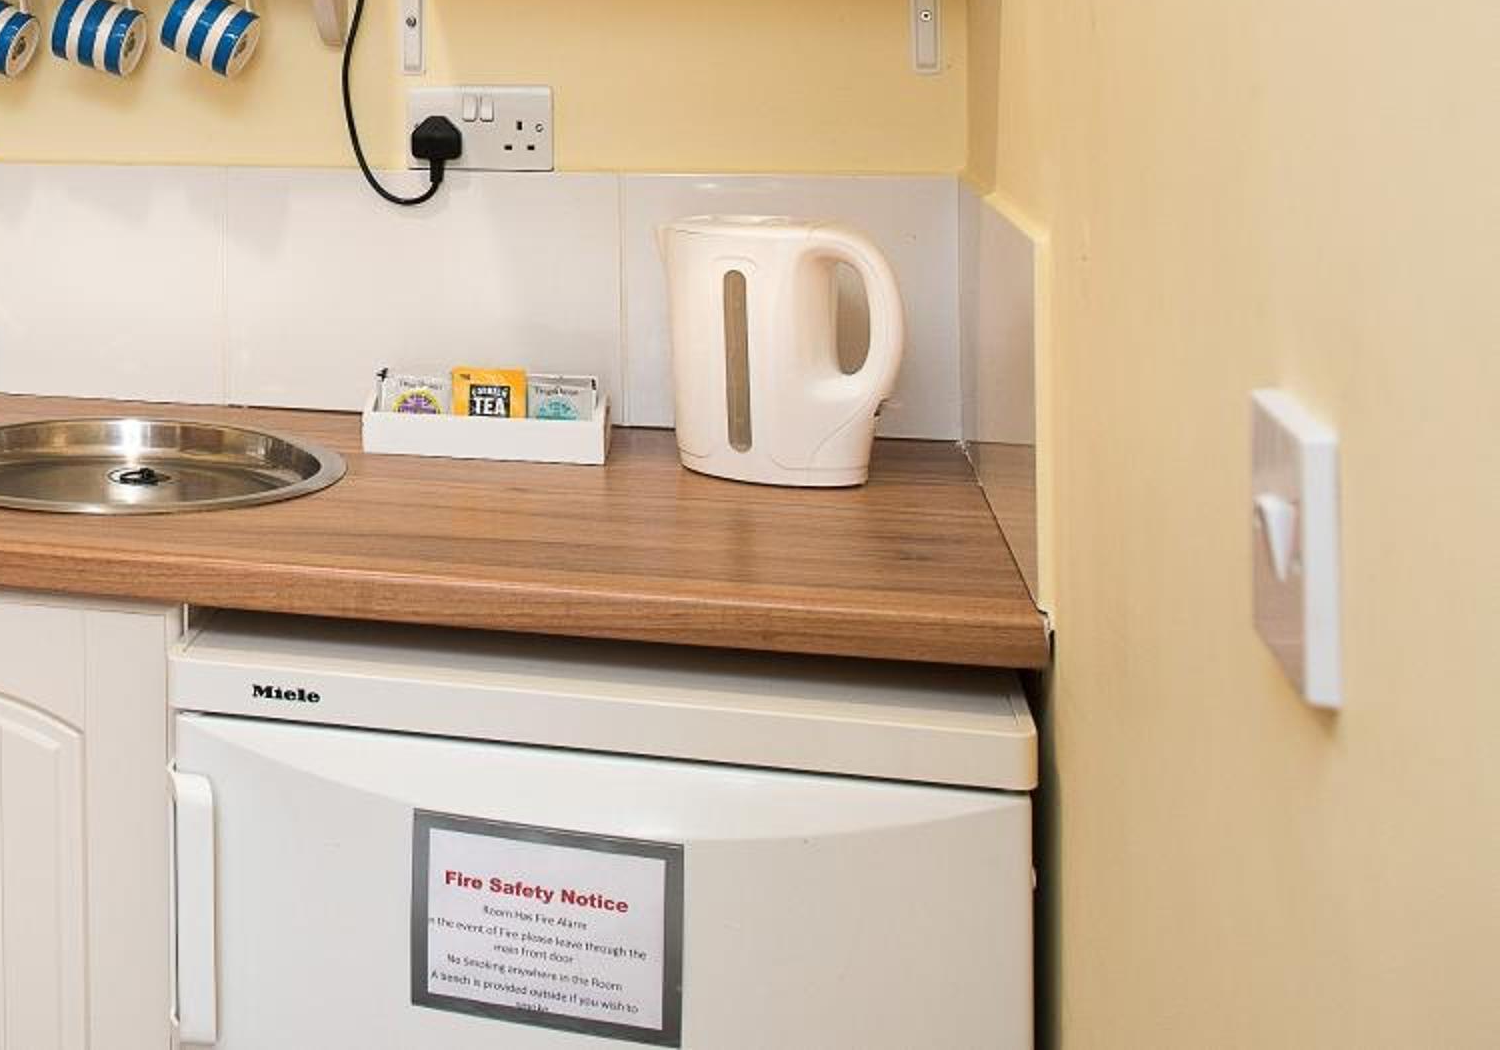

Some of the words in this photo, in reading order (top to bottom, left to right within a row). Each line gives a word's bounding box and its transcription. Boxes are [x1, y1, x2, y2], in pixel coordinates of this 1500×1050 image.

[473, 397, 506, 415] TEA
[252, 684, 320, 703] Miele
[445, 870, 483, 889] Fire
[489, 877, 554, 904] Safety
[561, 889, 629, 913] Notice
[535, 913, 555, 926] Fire
[437, 917, 453, 928] the
[456, 921, 483, 934] event
[485, 926, 497, 935] of
[499, 927, 519, 937] Fire
[521, 931, 553, 945] please
[556, 937, 583, 950] leave
[585, 943, 626, 958] through
[629, 949, 647, 961] the
[521, 947, 547, 960] front
[549, 952, 573, 962] door
[447, 953, 461, 965] No
[463, 957, 506, 974] Smoking
[508, 965, 557, 981] anywhere
[559, 973, 570, 982] in
[571, 975, 589, 986] the
[591, 977, 623, 991] Room
[431, 970, 439, 980] A
[473, 979, 481, 987] is
[483, 981, 527, 995] provided
[529, 989, 567, 1002] outside
[569, 993, 577, 1003] if
[579, 997, 599, 1007] you
[601, 1001, 625, 1012] wish
[626, 1003, 639, 1014] to
